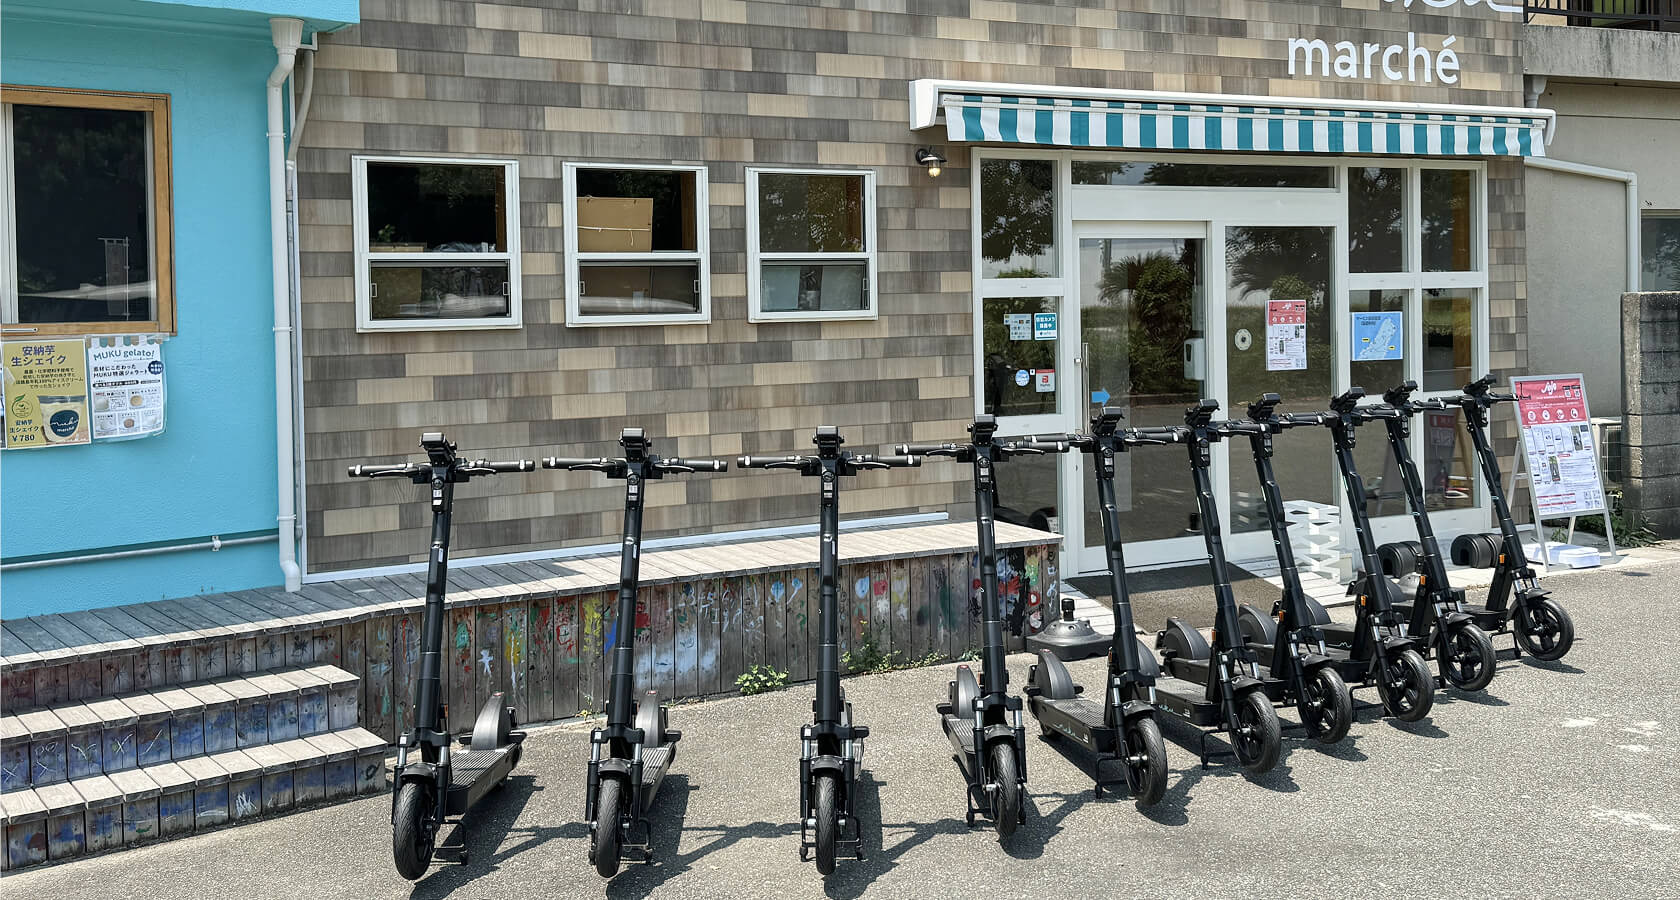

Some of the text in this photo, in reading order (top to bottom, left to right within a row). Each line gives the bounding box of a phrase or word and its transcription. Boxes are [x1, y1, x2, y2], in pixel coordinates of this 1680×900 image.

[1288, 32, 1460, 84] marché
[22, 345, 56, 356] 安納芋
[93, 348, 155, 361] MUKU gelato!
[11, 355, 66, 367] 生シェイク
